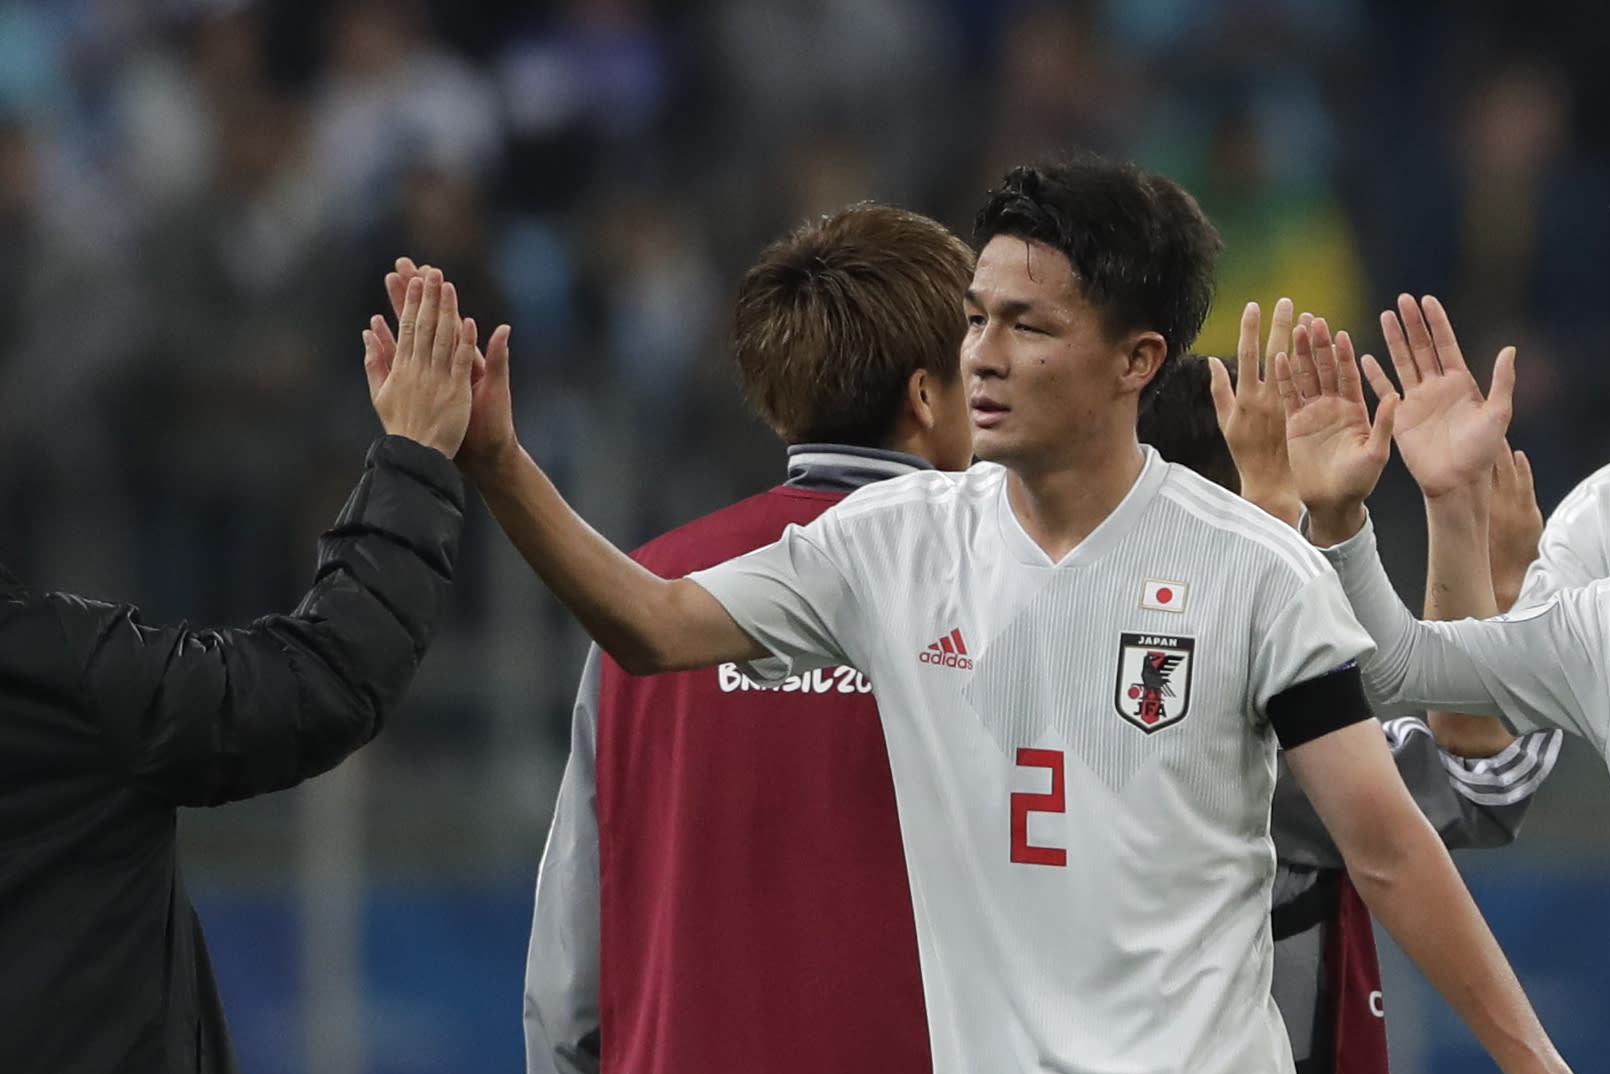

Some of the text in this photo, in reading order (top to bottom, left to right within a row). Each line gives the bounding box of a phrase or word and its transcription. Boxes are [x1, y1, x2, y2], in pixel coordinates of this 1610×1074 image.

[1138, 636, 1177, 647] JAPAN
[919, 651, 974, 670] adidas
[1133, 701, 1167, 718] JFA
[1010, 747, 1067, 867] 2
